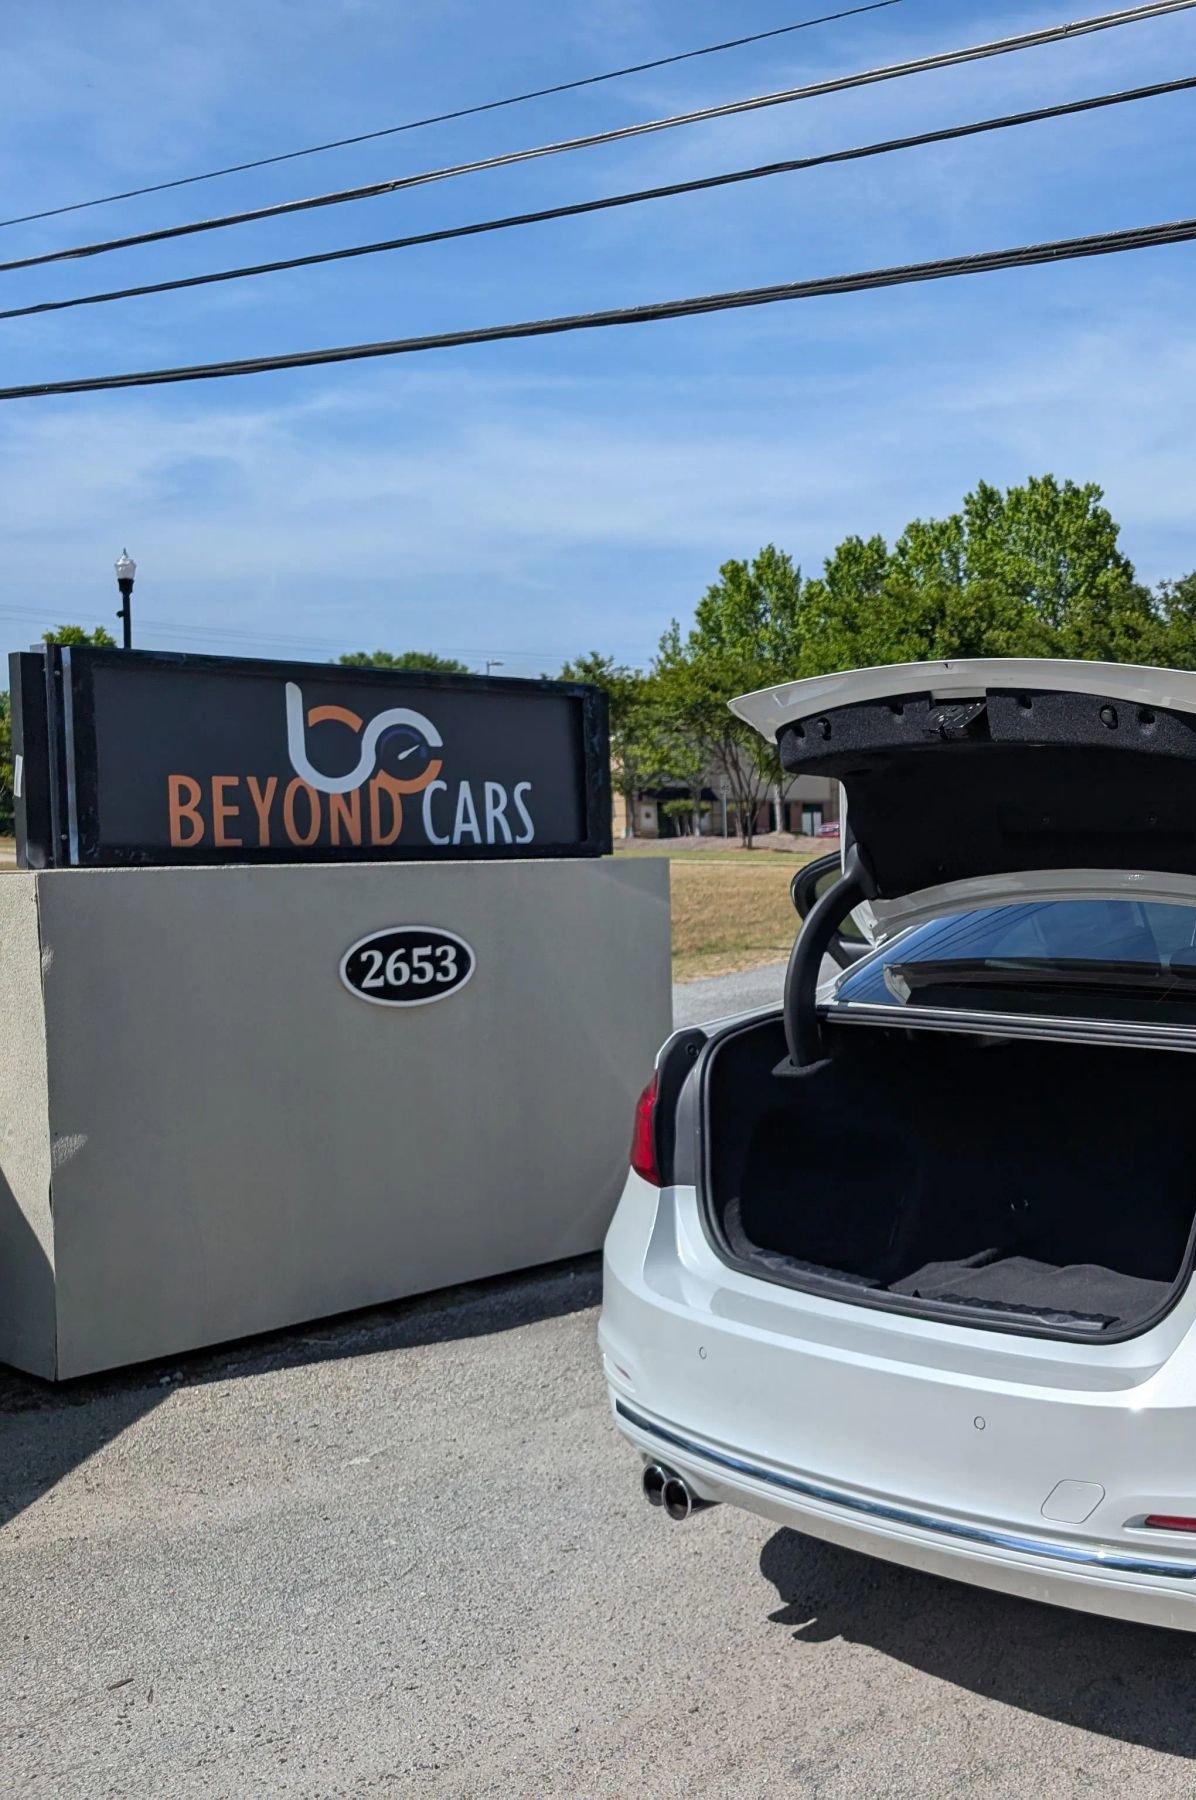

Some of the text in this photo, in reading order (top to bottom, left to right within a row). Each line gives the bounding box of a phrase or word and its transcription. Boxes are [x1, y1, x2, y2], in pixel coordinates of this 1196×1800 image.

[168, 775, 535, 847] BEYOND CARS
[361, 945, 458, 988] 2653
